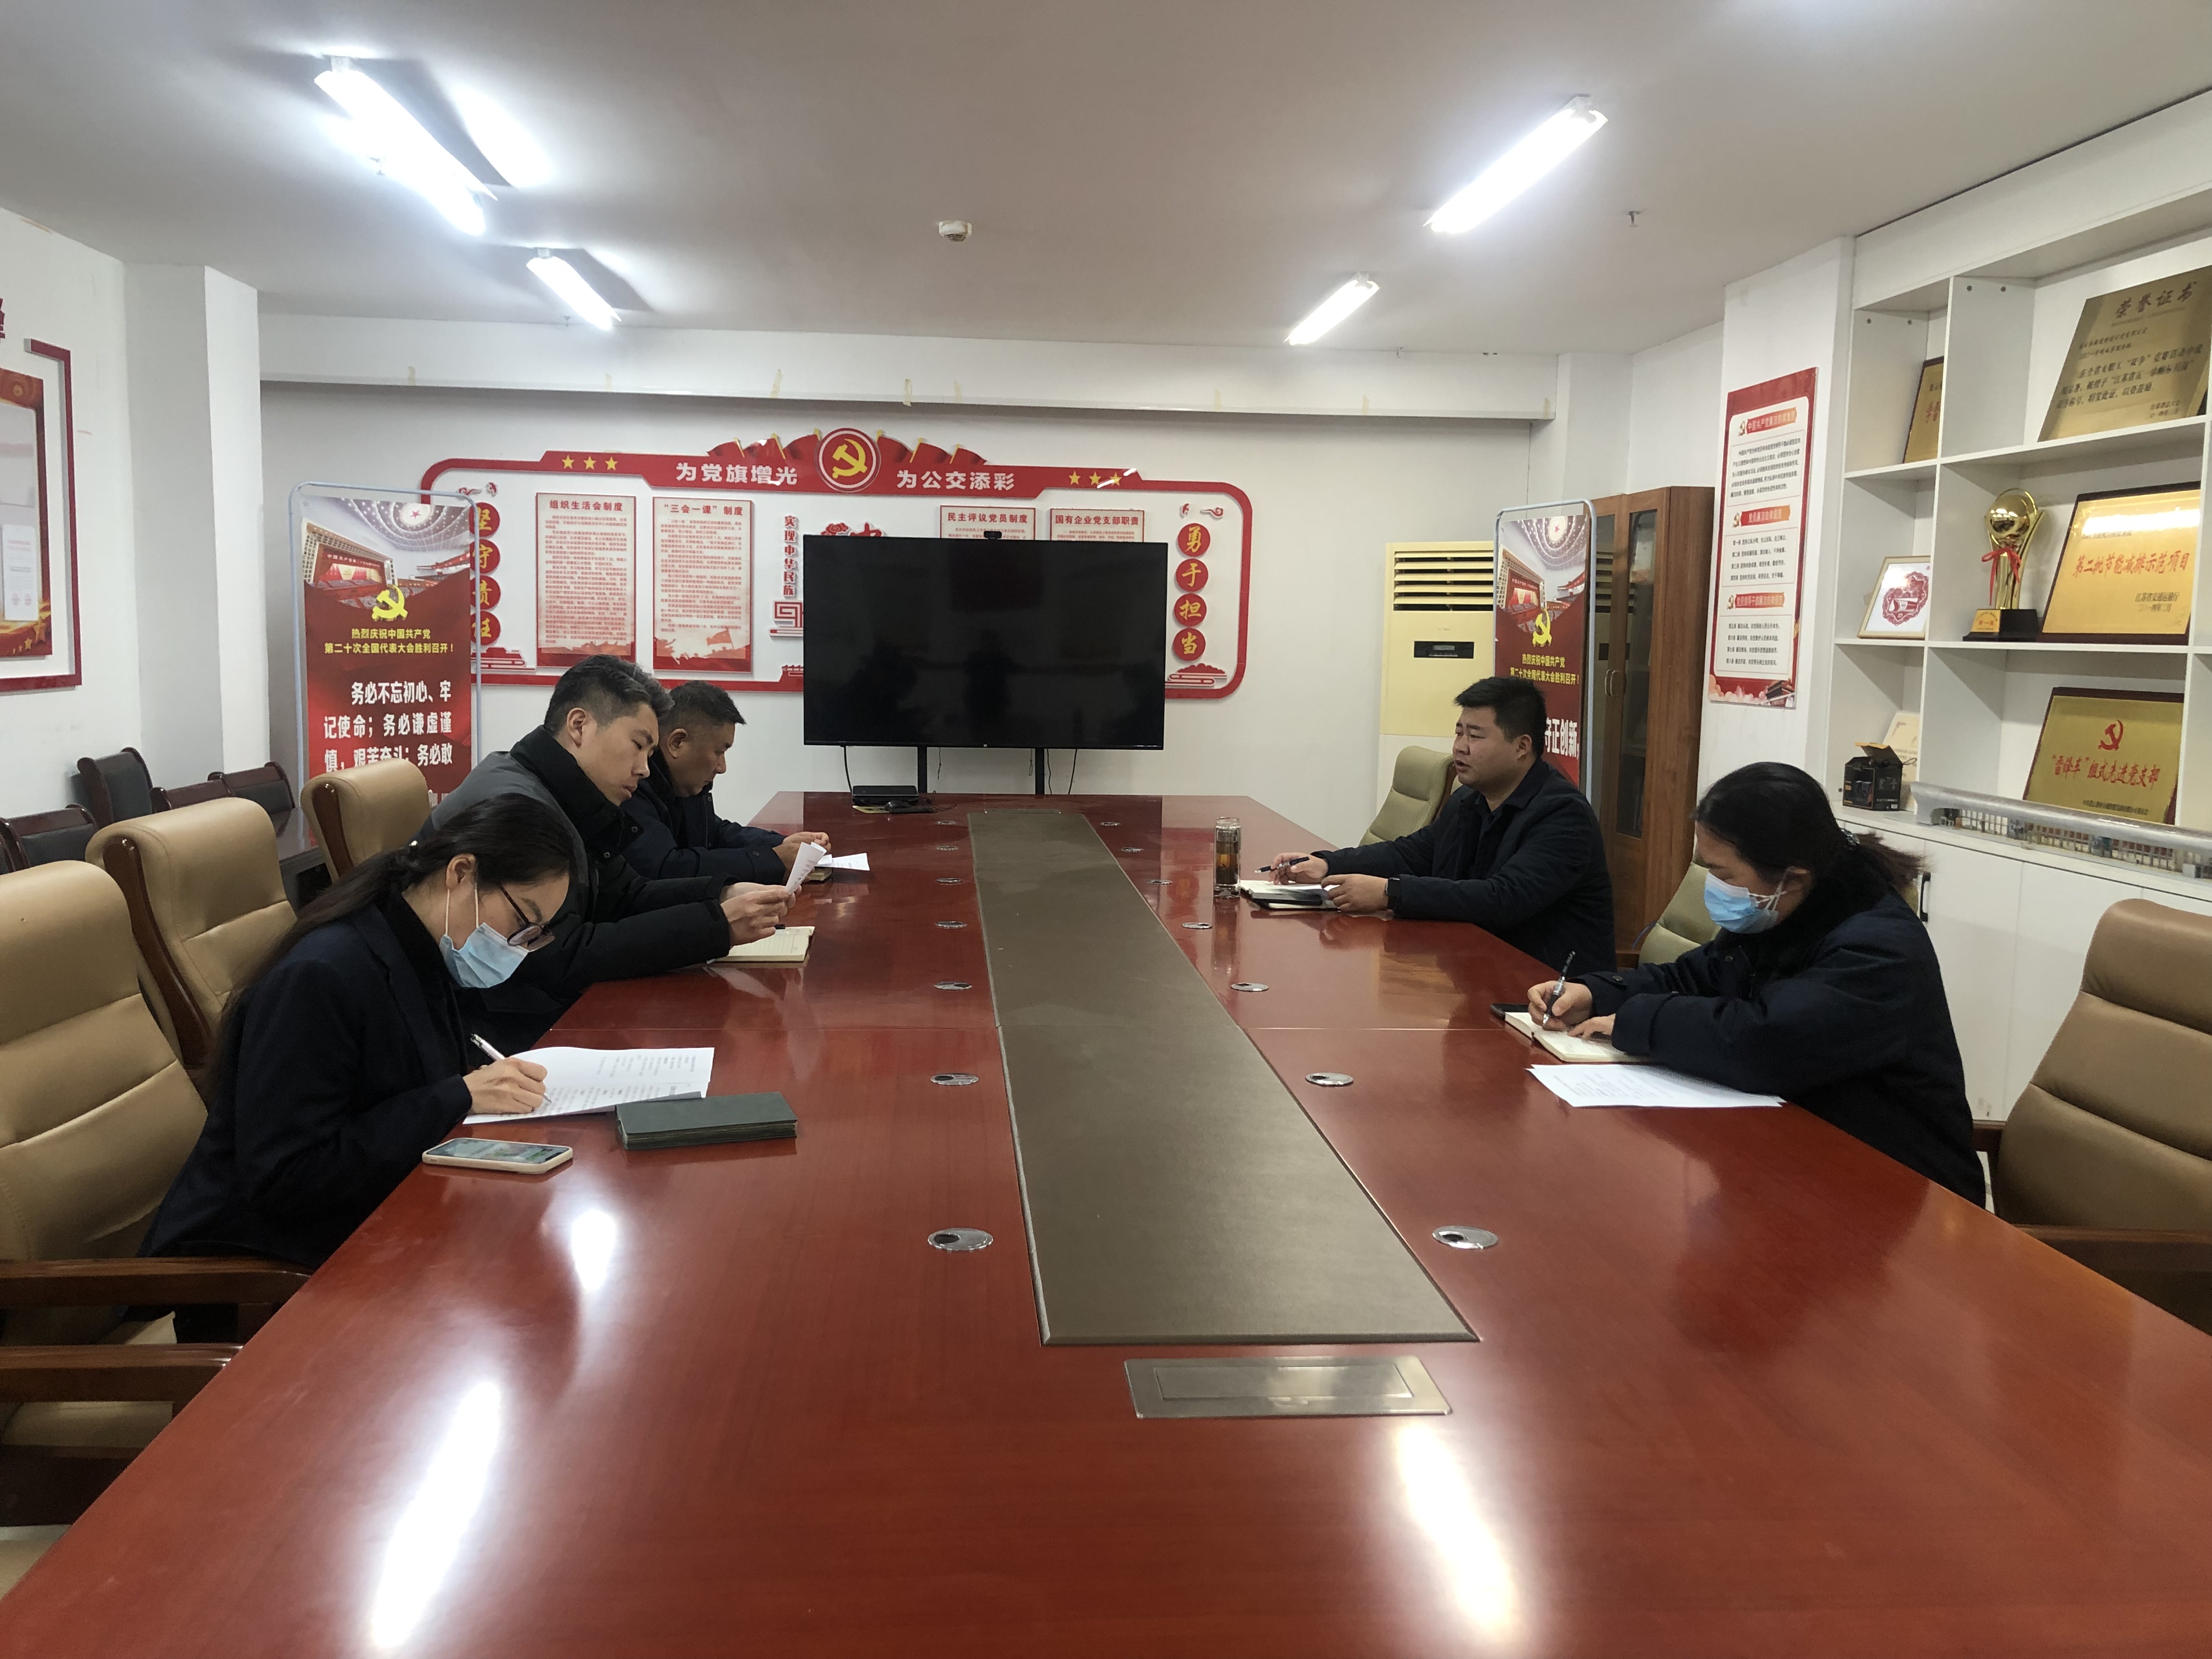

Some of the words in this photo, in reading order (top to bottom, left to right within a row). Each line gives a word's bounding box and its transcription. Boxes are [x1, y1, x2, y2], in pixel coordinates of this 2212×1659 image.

[2115, 281, 2197, 319] 荣誉证书
[676, 462, 798, 486] 为党旗增光
[896, 470, 1014, 490] 为公交添彩
[549, 500, 623, 511] 组织生活会制度
[947, 512, 1028, 523] 民主评议党员制度
[1055, 515, 1138, 525] 国有企业党支部职责
[783, 515, 796, 596] 实现中华民族
[2073, 550, 2190, 578] 第二批节能减排示范项目
[1180, 526, 1202, 654] 勇于担当
[352, 628, 431, 639] 热烈庆祝中国共产党
[324, 642, 454, 654] 第二十次全国代表大会胜利召开！
[1522, 653, 1565, 668] 热烈庆祝中国共产党
[351, 680, 451, 705] 务必不忘初心、牢
[324, 711, 452, 739] 记使命；务必谦虚谨
